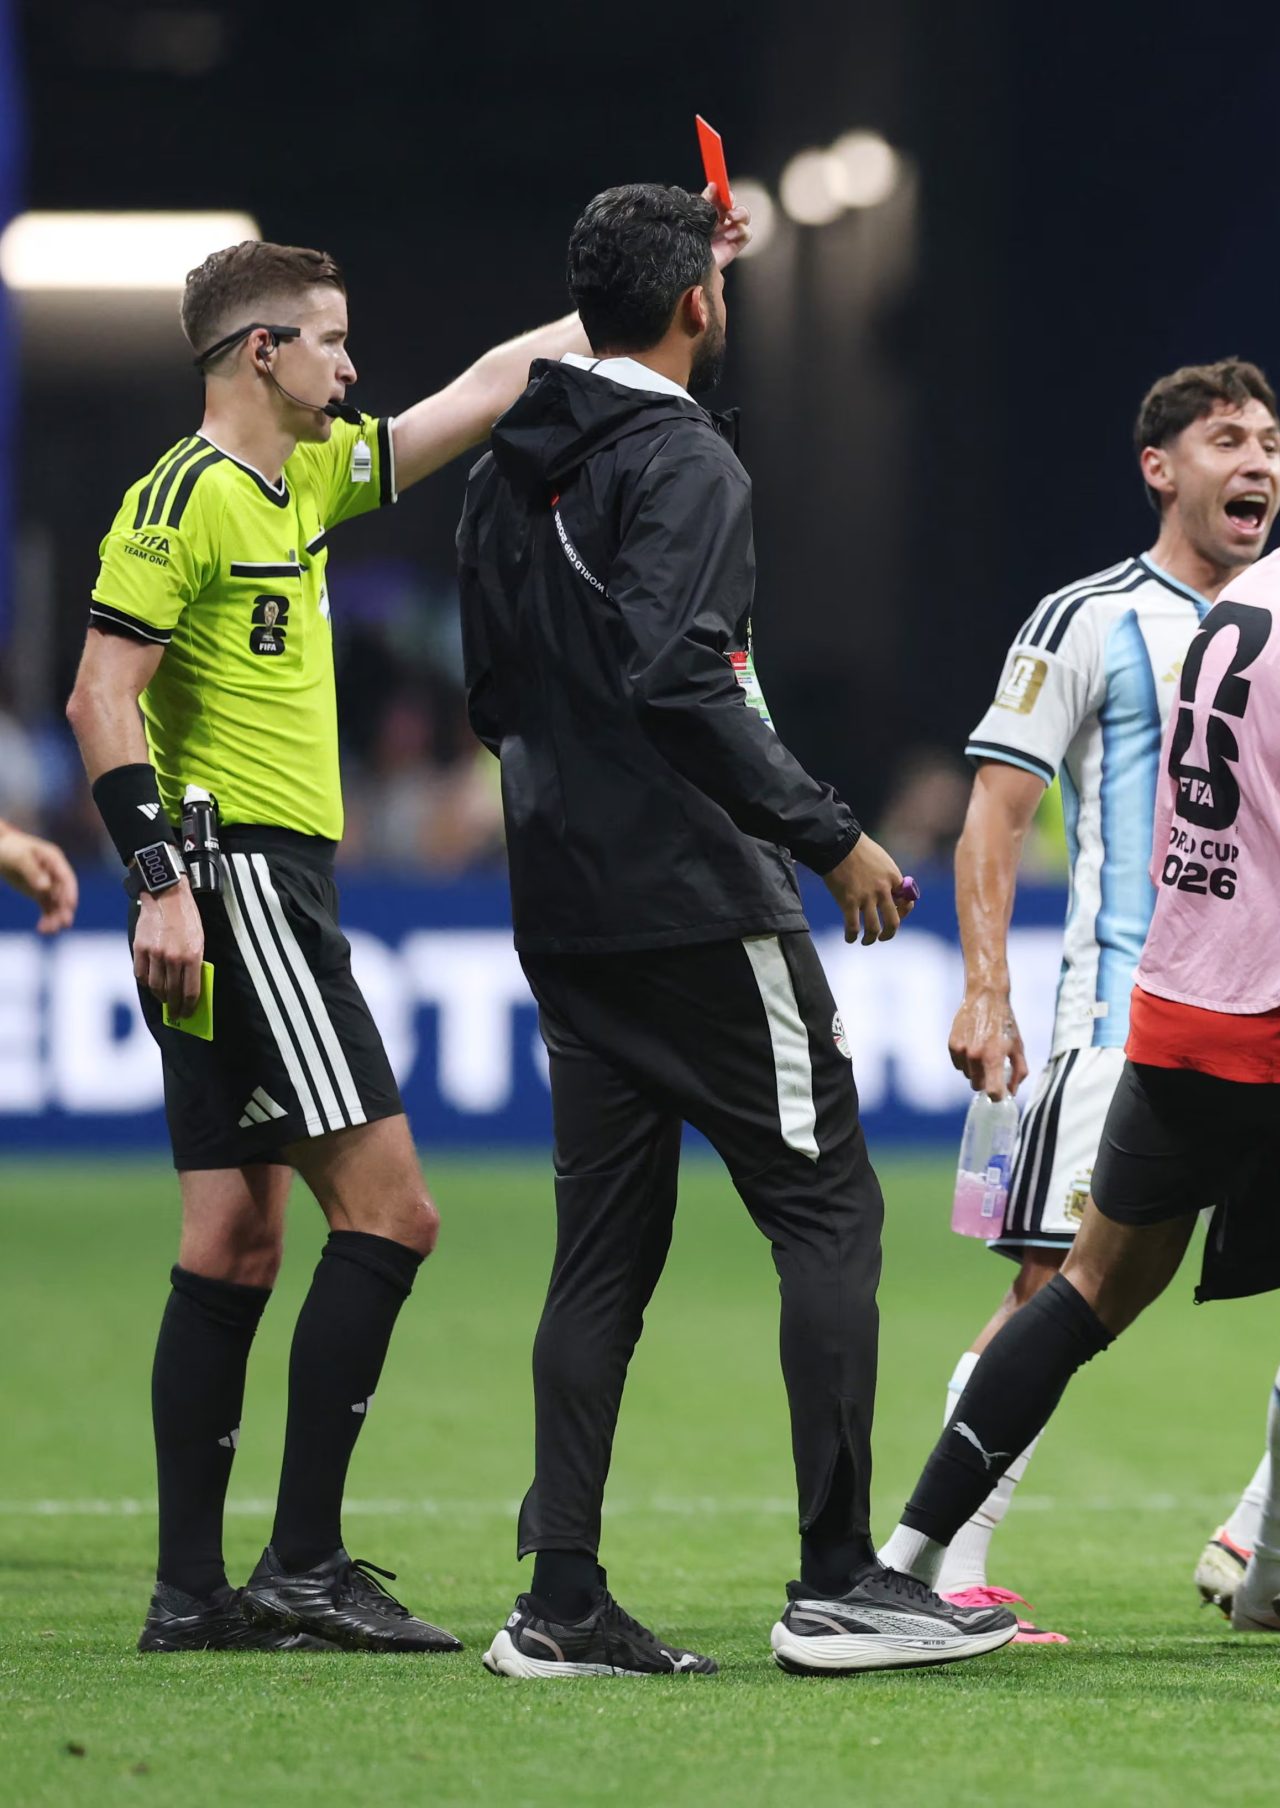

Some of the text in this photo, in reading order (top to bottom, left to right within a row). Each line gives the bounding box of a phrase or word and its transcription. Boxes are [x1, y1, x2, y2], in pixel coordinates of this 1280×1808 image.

[124, 545, 169, 567] TEAM ONE
[565, 543, 576, 561] CUP
[575, 561, 604, 592] WORLD
[259, 643, 277, 652] FIFA
[1200, 840, 1239, 863] CUP
